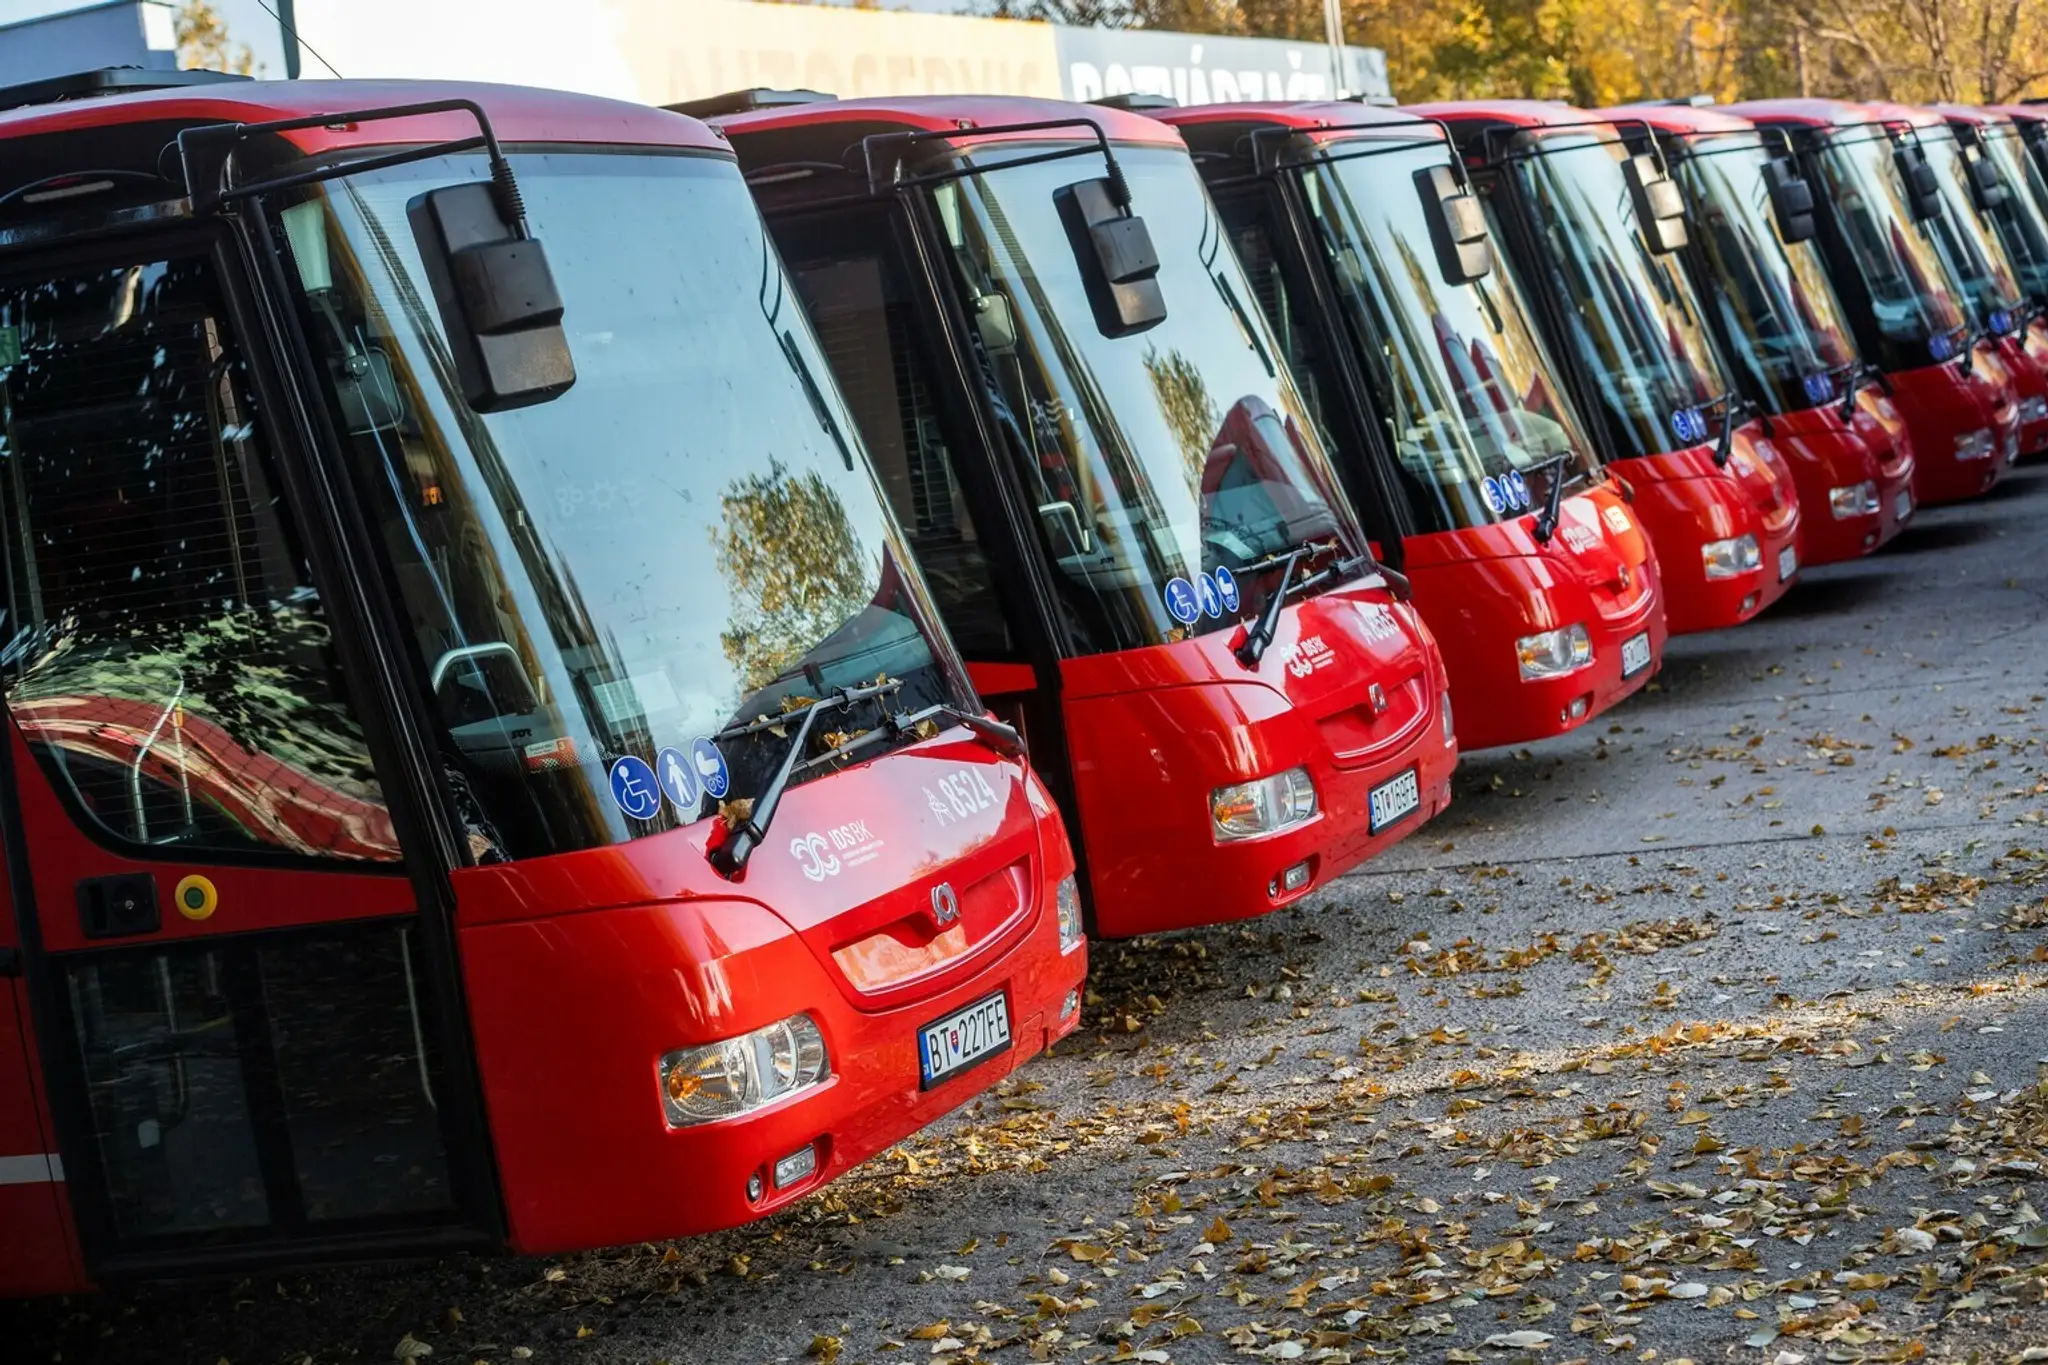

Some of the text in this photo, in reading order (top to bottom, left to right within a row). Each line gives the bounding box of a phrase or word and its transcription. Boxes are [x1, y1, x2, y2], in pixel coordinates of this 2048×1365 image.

[938, 766, 999, 818] 8524
[929, 999, 1007, 1074] BT 227FE
